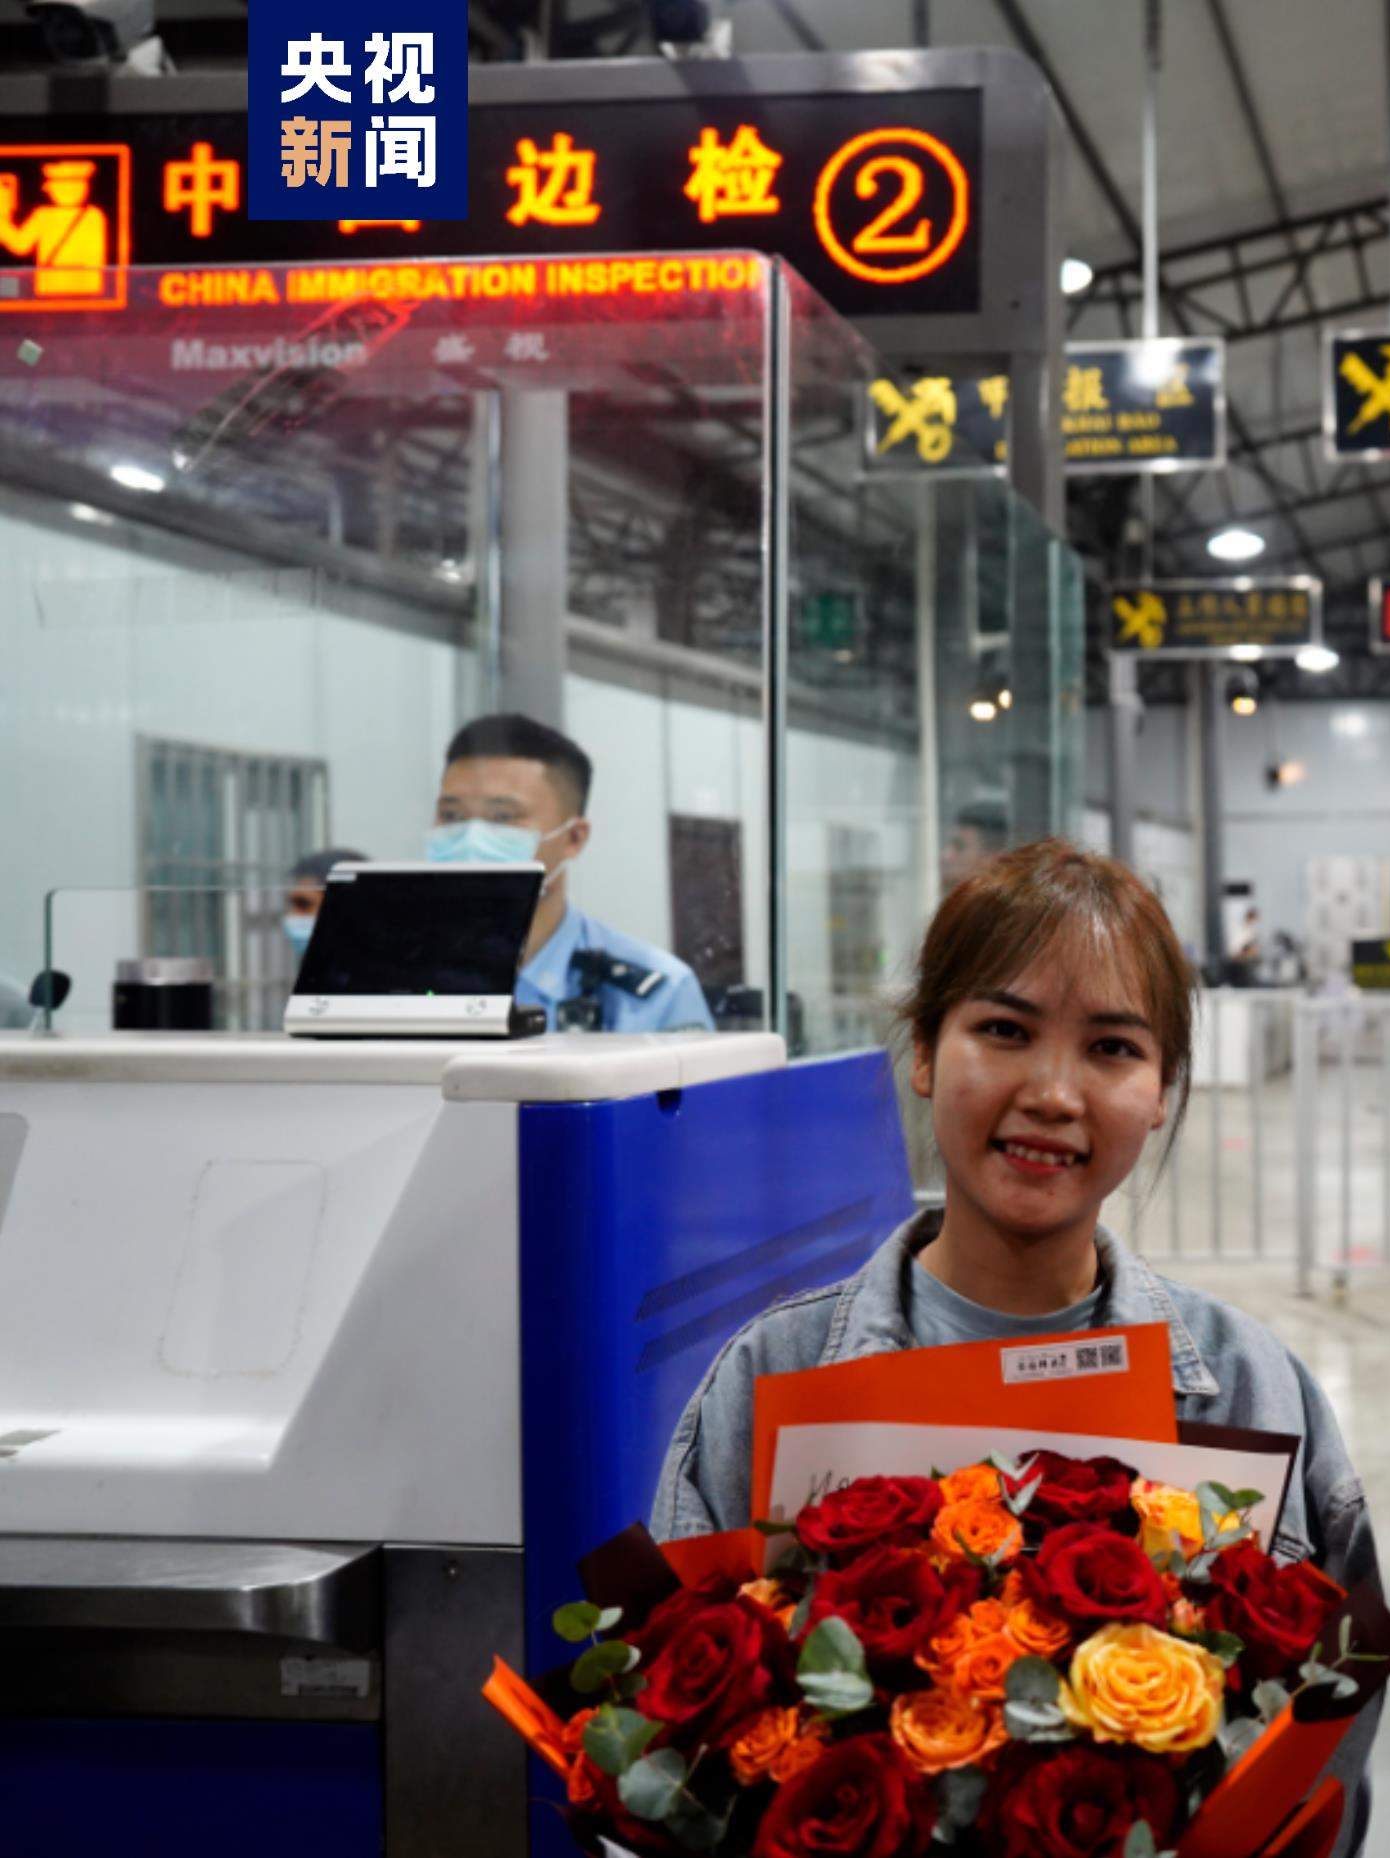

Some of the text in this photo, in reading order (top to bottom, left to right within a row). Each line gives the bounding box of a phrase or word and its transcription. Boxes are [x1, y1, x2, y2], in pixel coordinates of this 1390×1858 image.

[165, 126, 781, 234] 中边检
[160, 270, 279, 306] CHINA
[286, 263, 536, 304] IMMIGRATION
[171, 335, 367, 370] Maxvision
